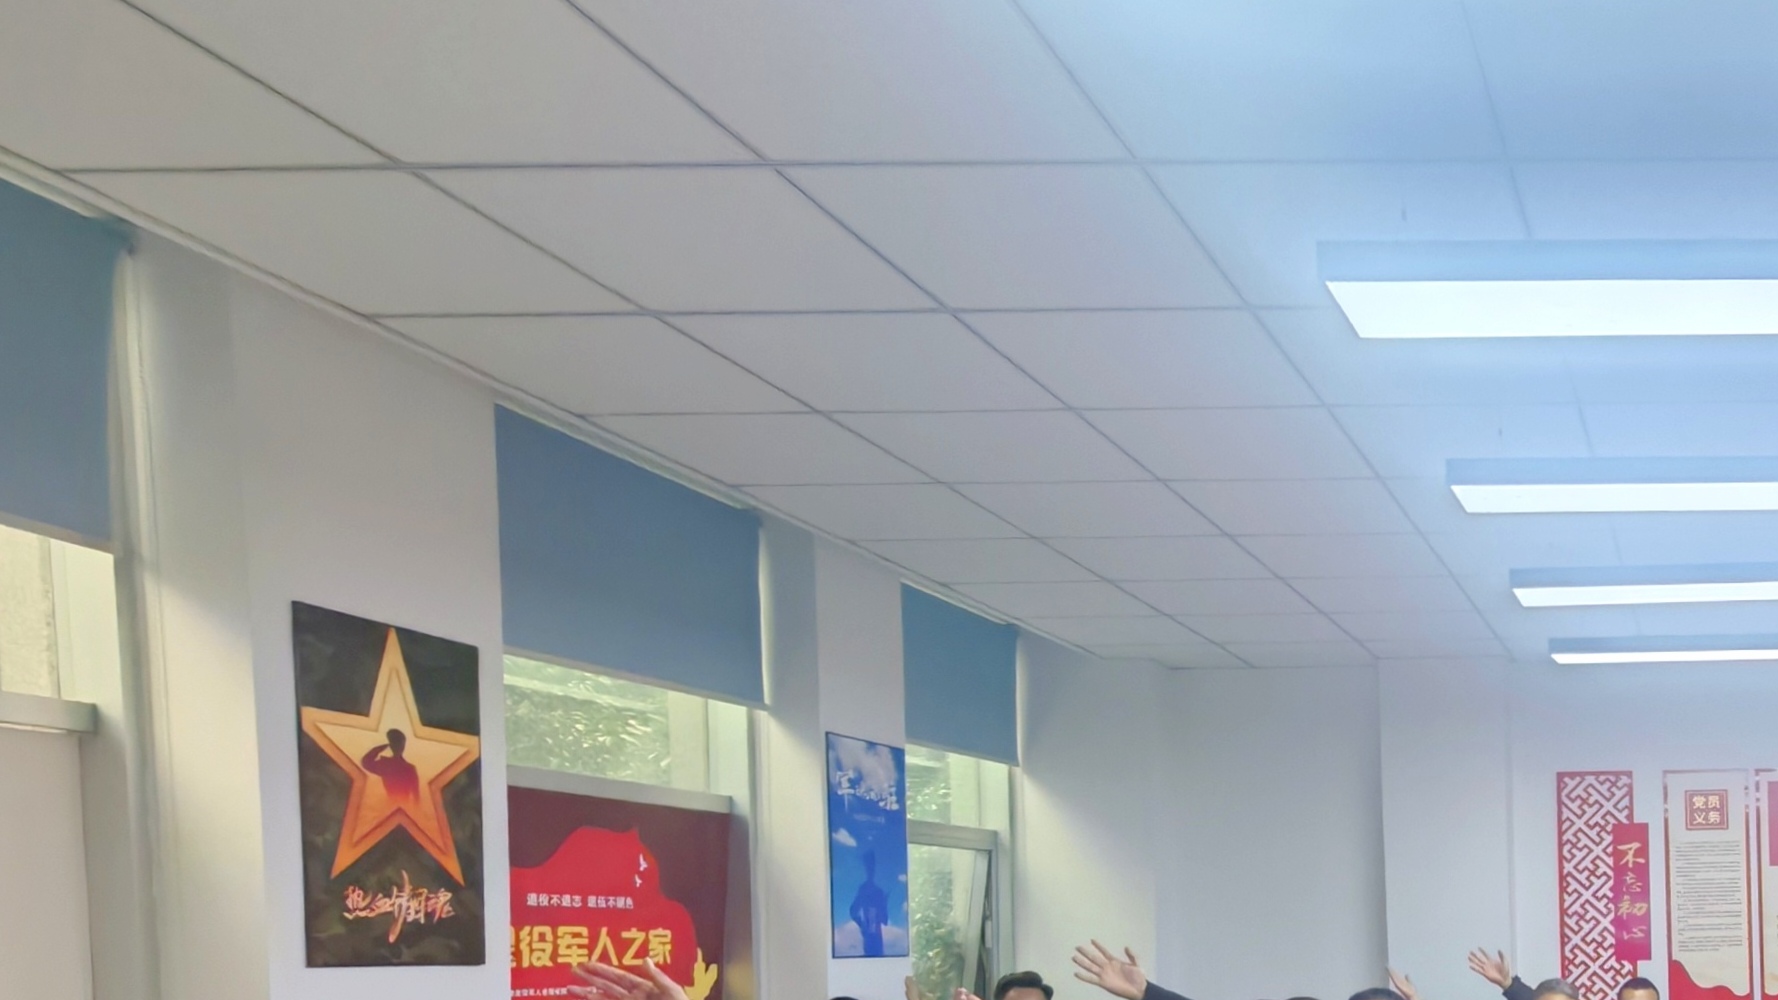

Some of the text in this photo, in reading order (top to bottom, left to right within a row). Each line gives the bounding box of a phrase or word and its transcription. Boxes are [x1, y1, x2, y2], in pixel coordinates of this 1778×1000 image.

[1692, 795, 1720, 809] 党员
[1692, 811, 1721, 825] 义务
[1616, 842, 1648, 940] 不忘初心
[527, 893, 582, 908] 退役不退志
